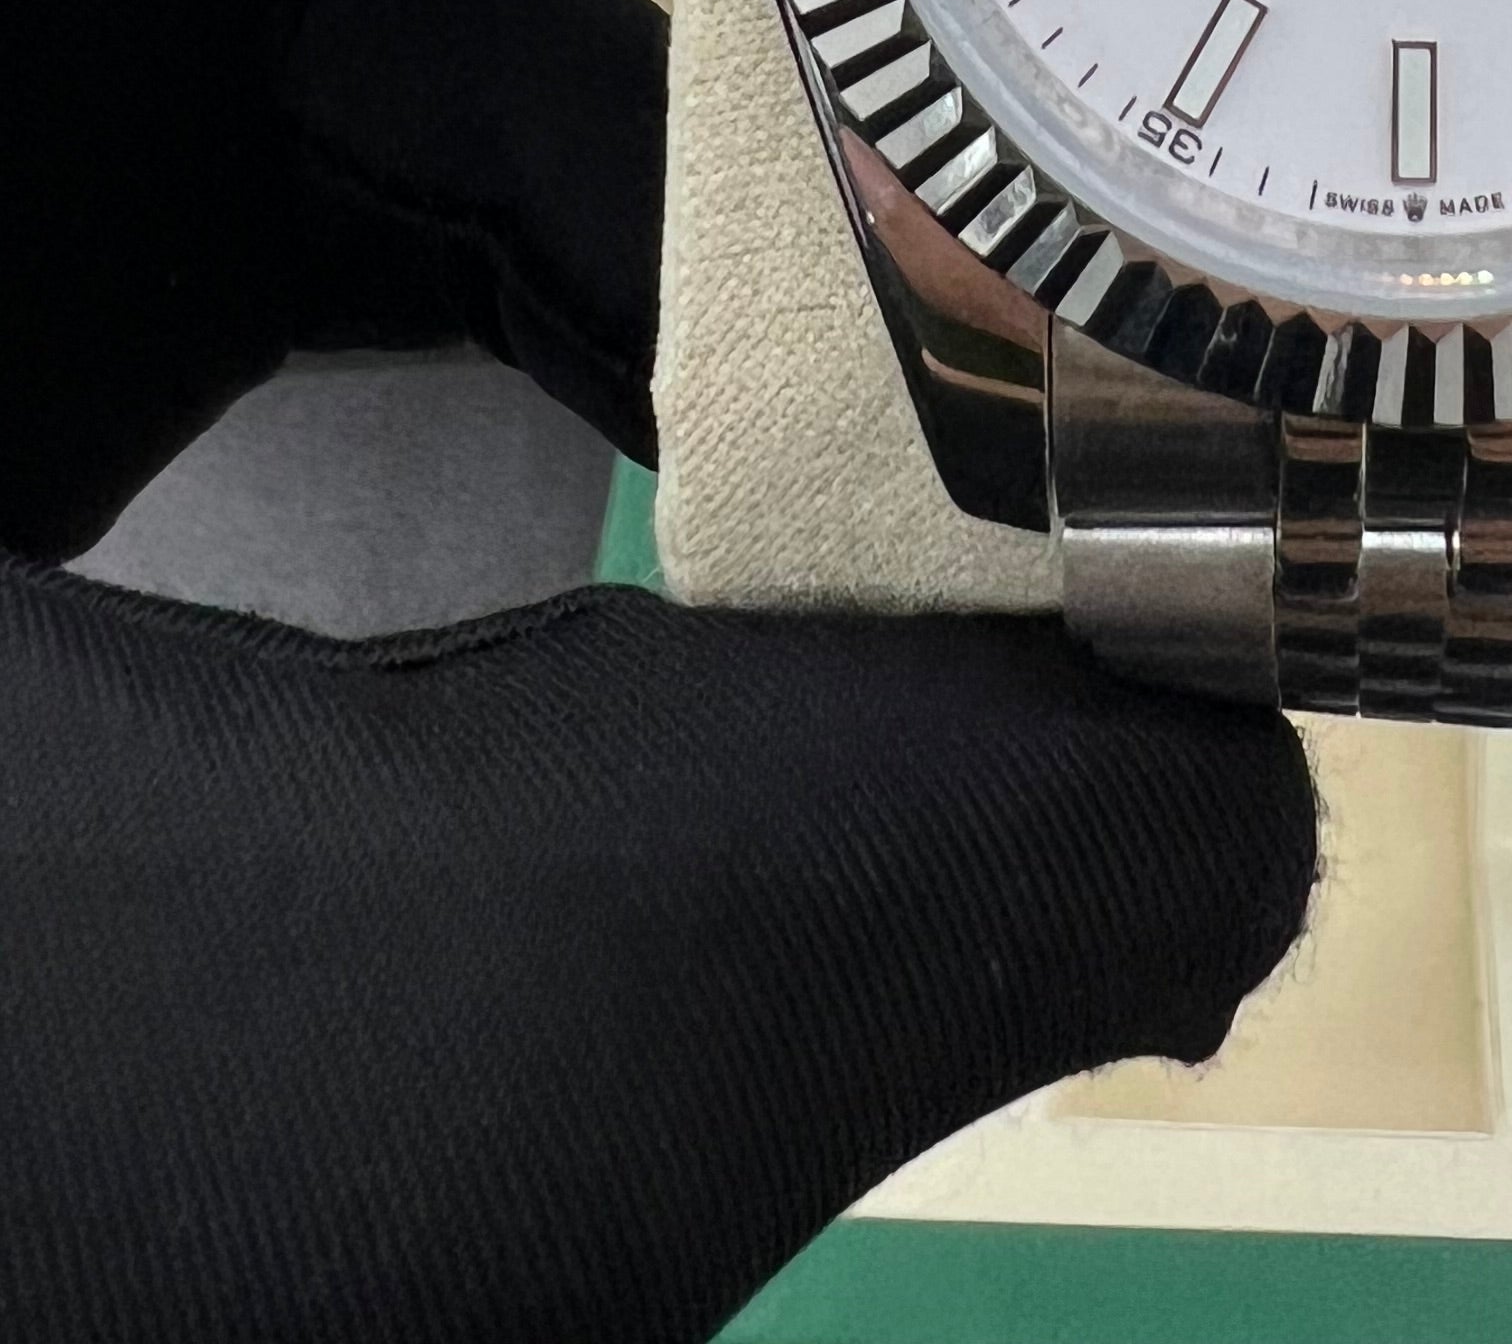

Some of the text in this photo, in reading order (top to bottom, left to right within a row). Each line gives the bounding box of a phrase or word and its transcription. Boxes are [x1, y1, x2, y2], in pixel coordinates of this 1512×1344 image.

[1136, 112, 1204, 166] 35
[1325, 191, 1506, 217] SWISS MADE
